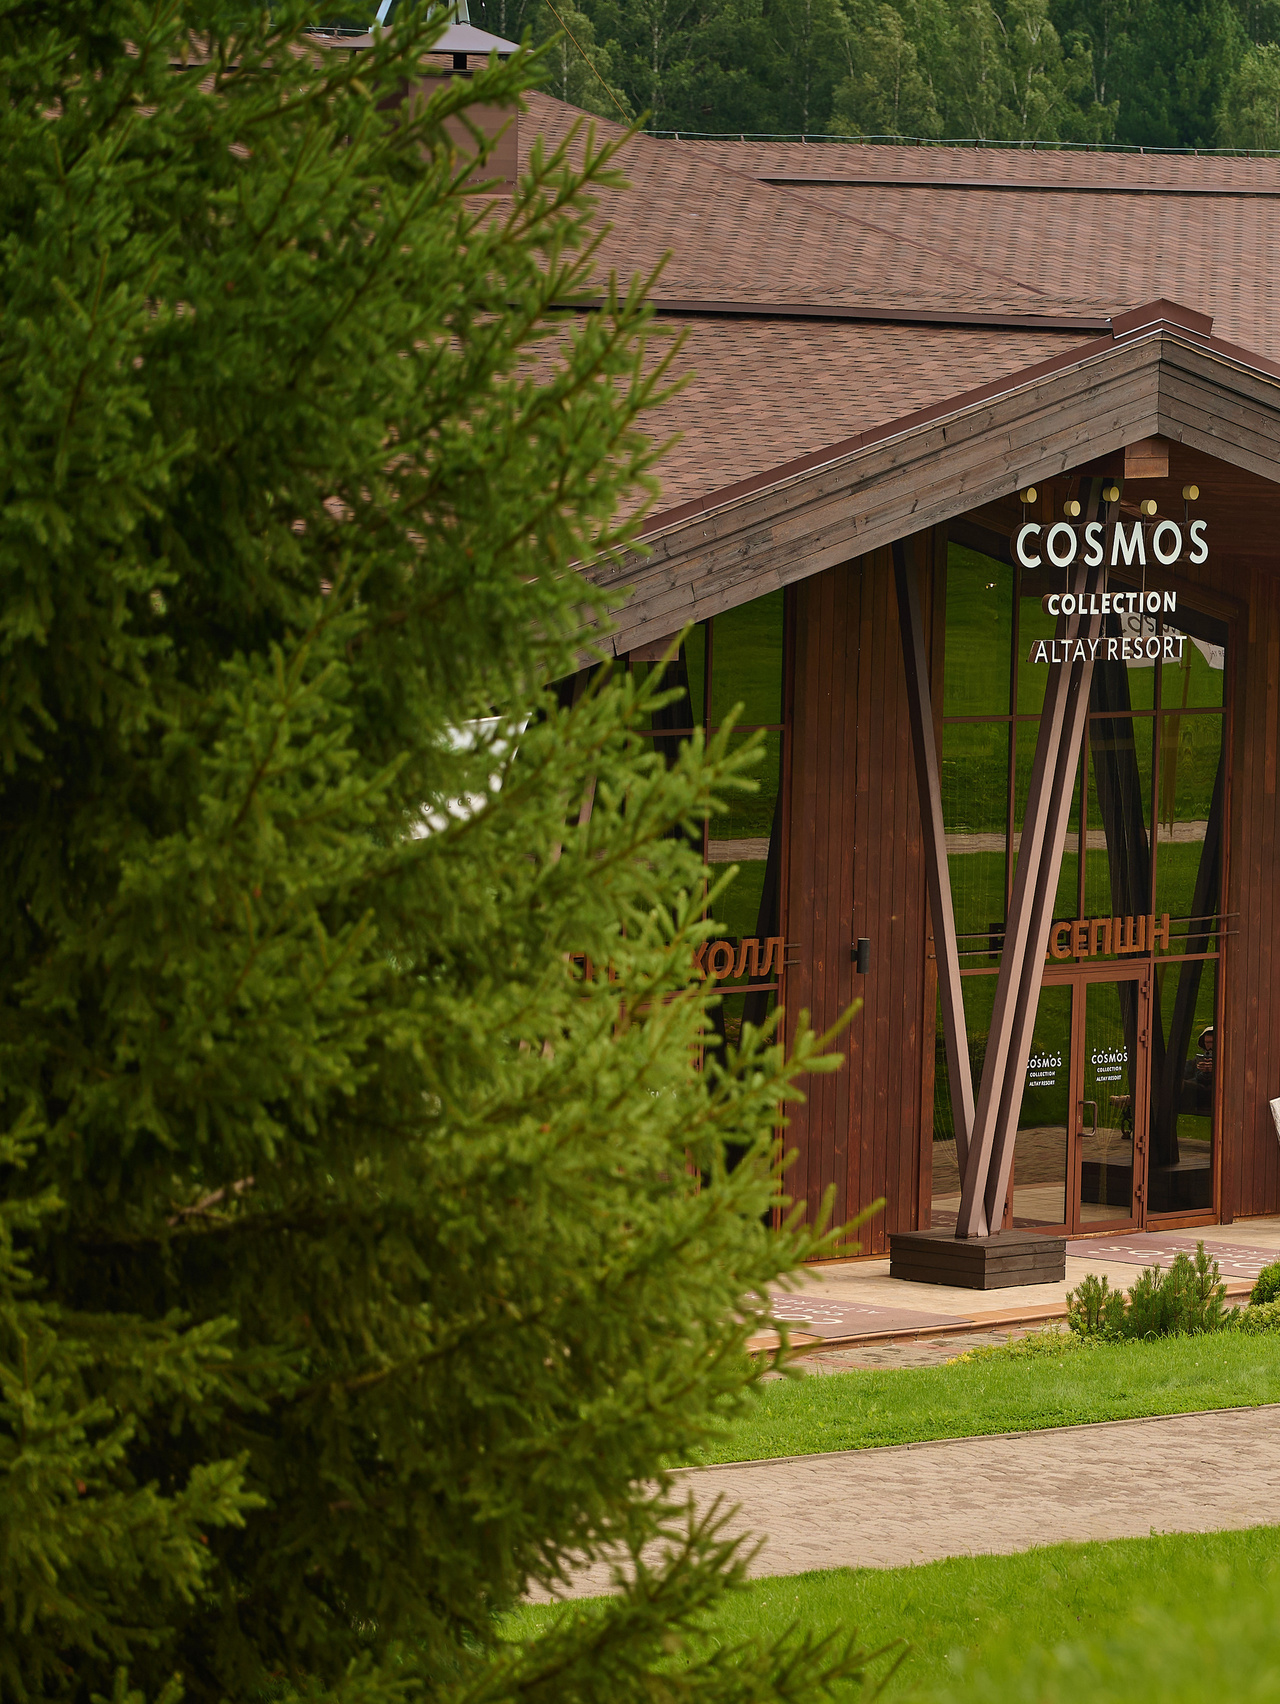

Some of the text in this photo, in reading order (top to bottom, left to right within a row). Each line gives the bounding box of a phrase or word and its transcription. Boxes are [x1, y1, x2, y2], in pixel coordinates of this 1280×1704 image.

[1016, 519, 1209, 569] COSMOS
[1047, 591, 1177, 616] COLLECTION
[1034, 635, 1188, 664] ALTAY RESORT
[1091, 1052, 1129, 1064] COSMOS
